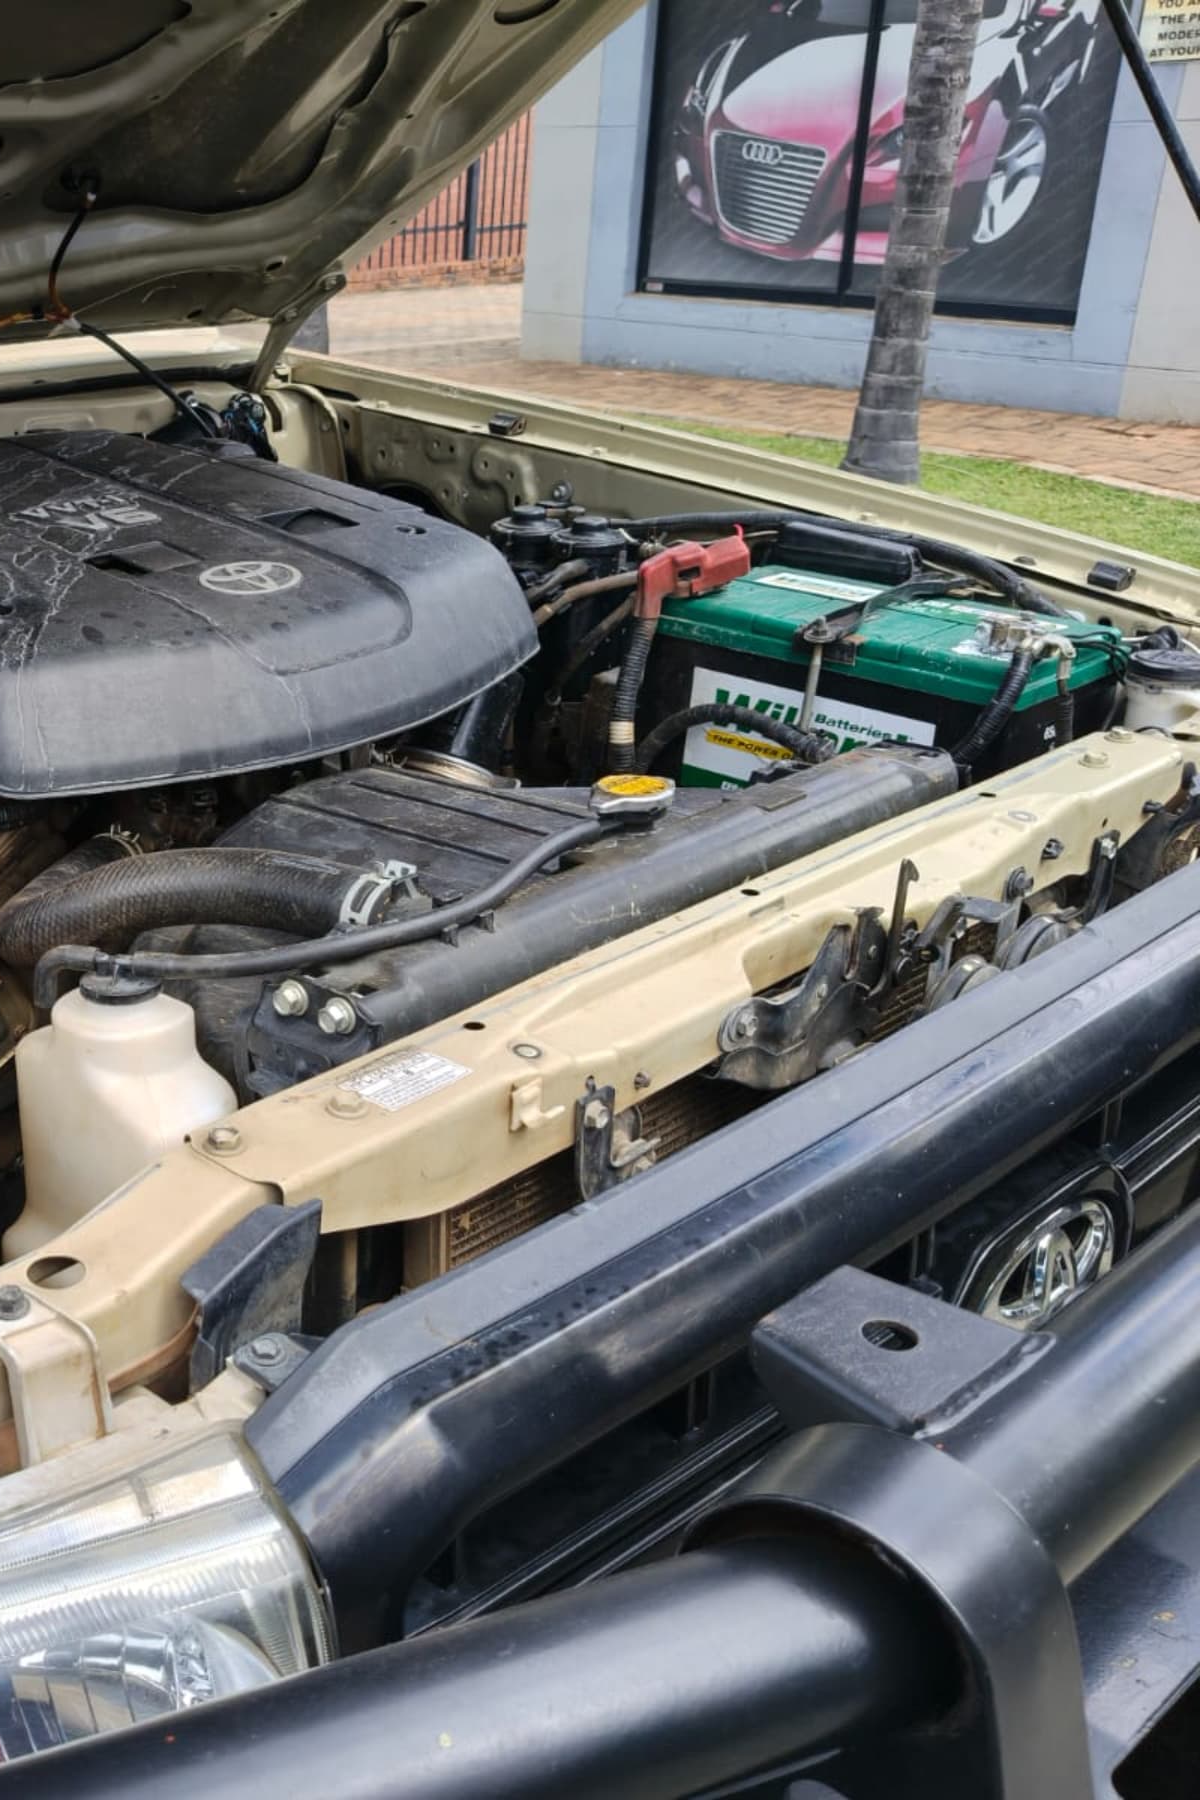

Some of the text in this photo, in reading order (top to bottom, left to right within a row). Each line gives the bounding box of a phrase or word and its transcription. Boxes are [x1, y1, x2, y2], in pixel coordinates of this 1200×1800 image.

[1160, 13, 1200, 24] THE P
[1150, 47, 1165, 58] AT
[815, 713, 892, 741] Batteries
[712, 734, 734, 745] THE
[737, 740, 778, 756] POWER
